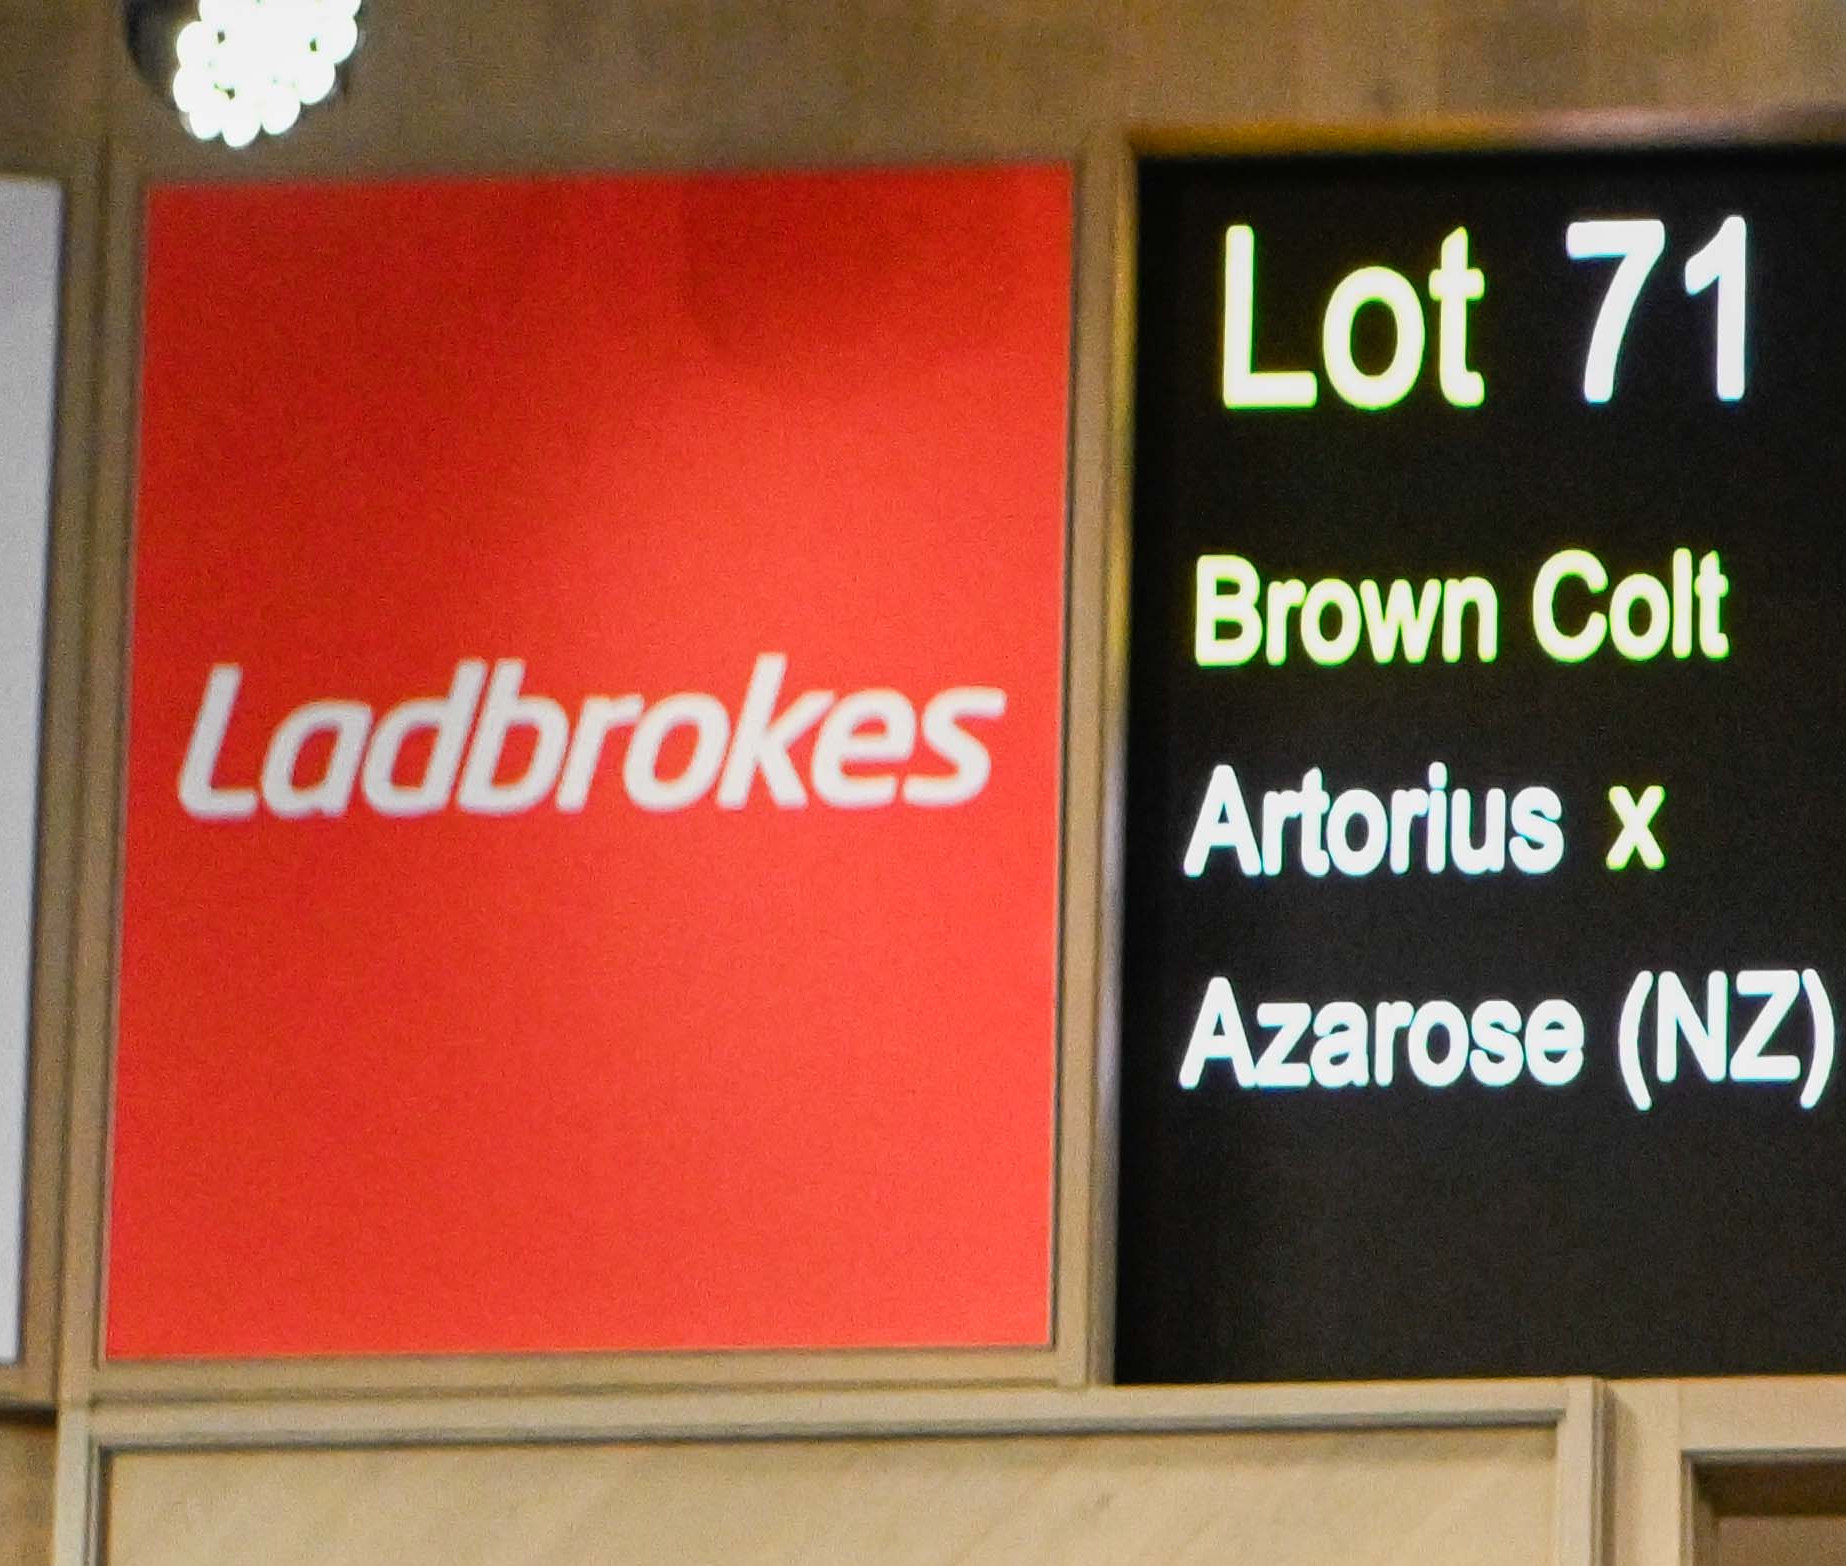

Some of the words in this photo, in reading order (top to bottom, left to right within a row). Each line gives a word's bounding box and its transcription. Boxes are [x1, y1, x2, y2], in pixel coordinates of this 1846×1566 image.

[1221, 222, 1487, 412] Lot
[1563, 212, 1749, 406] 71
[1191, 552, 1501, 668] Brown
[1529, 546, 1732, 664] Colt
[177, 650, 1009, 822] Ladbrokes
[1181, 760, 1567, 880] Artorius
[1603, 782, 1669, 872] x
[1177, 976, 1587, 1090] Azarose
[1617, 968, 1839, 1112] (NZ)
